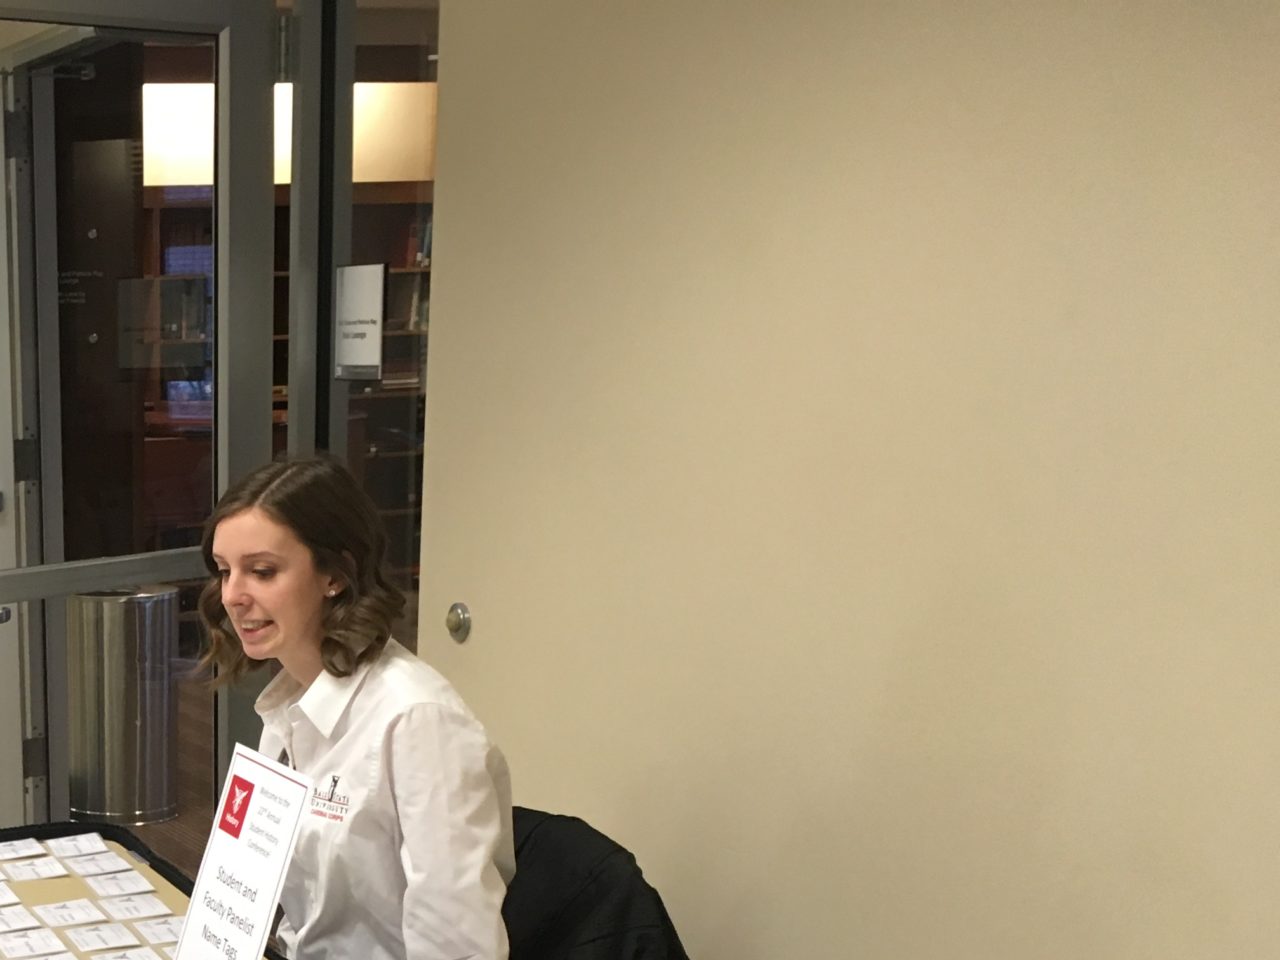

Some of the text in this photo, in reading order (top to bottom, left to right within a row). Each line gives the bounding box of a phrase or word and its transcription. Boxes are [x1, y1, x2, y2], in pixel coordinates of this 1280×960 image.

[225, 812, 239, 829] History
[216, 865, 259, 903] Student and
[203, 891, 255, 936] Faculty Panelist
[201, 923, 221, 949] Name
